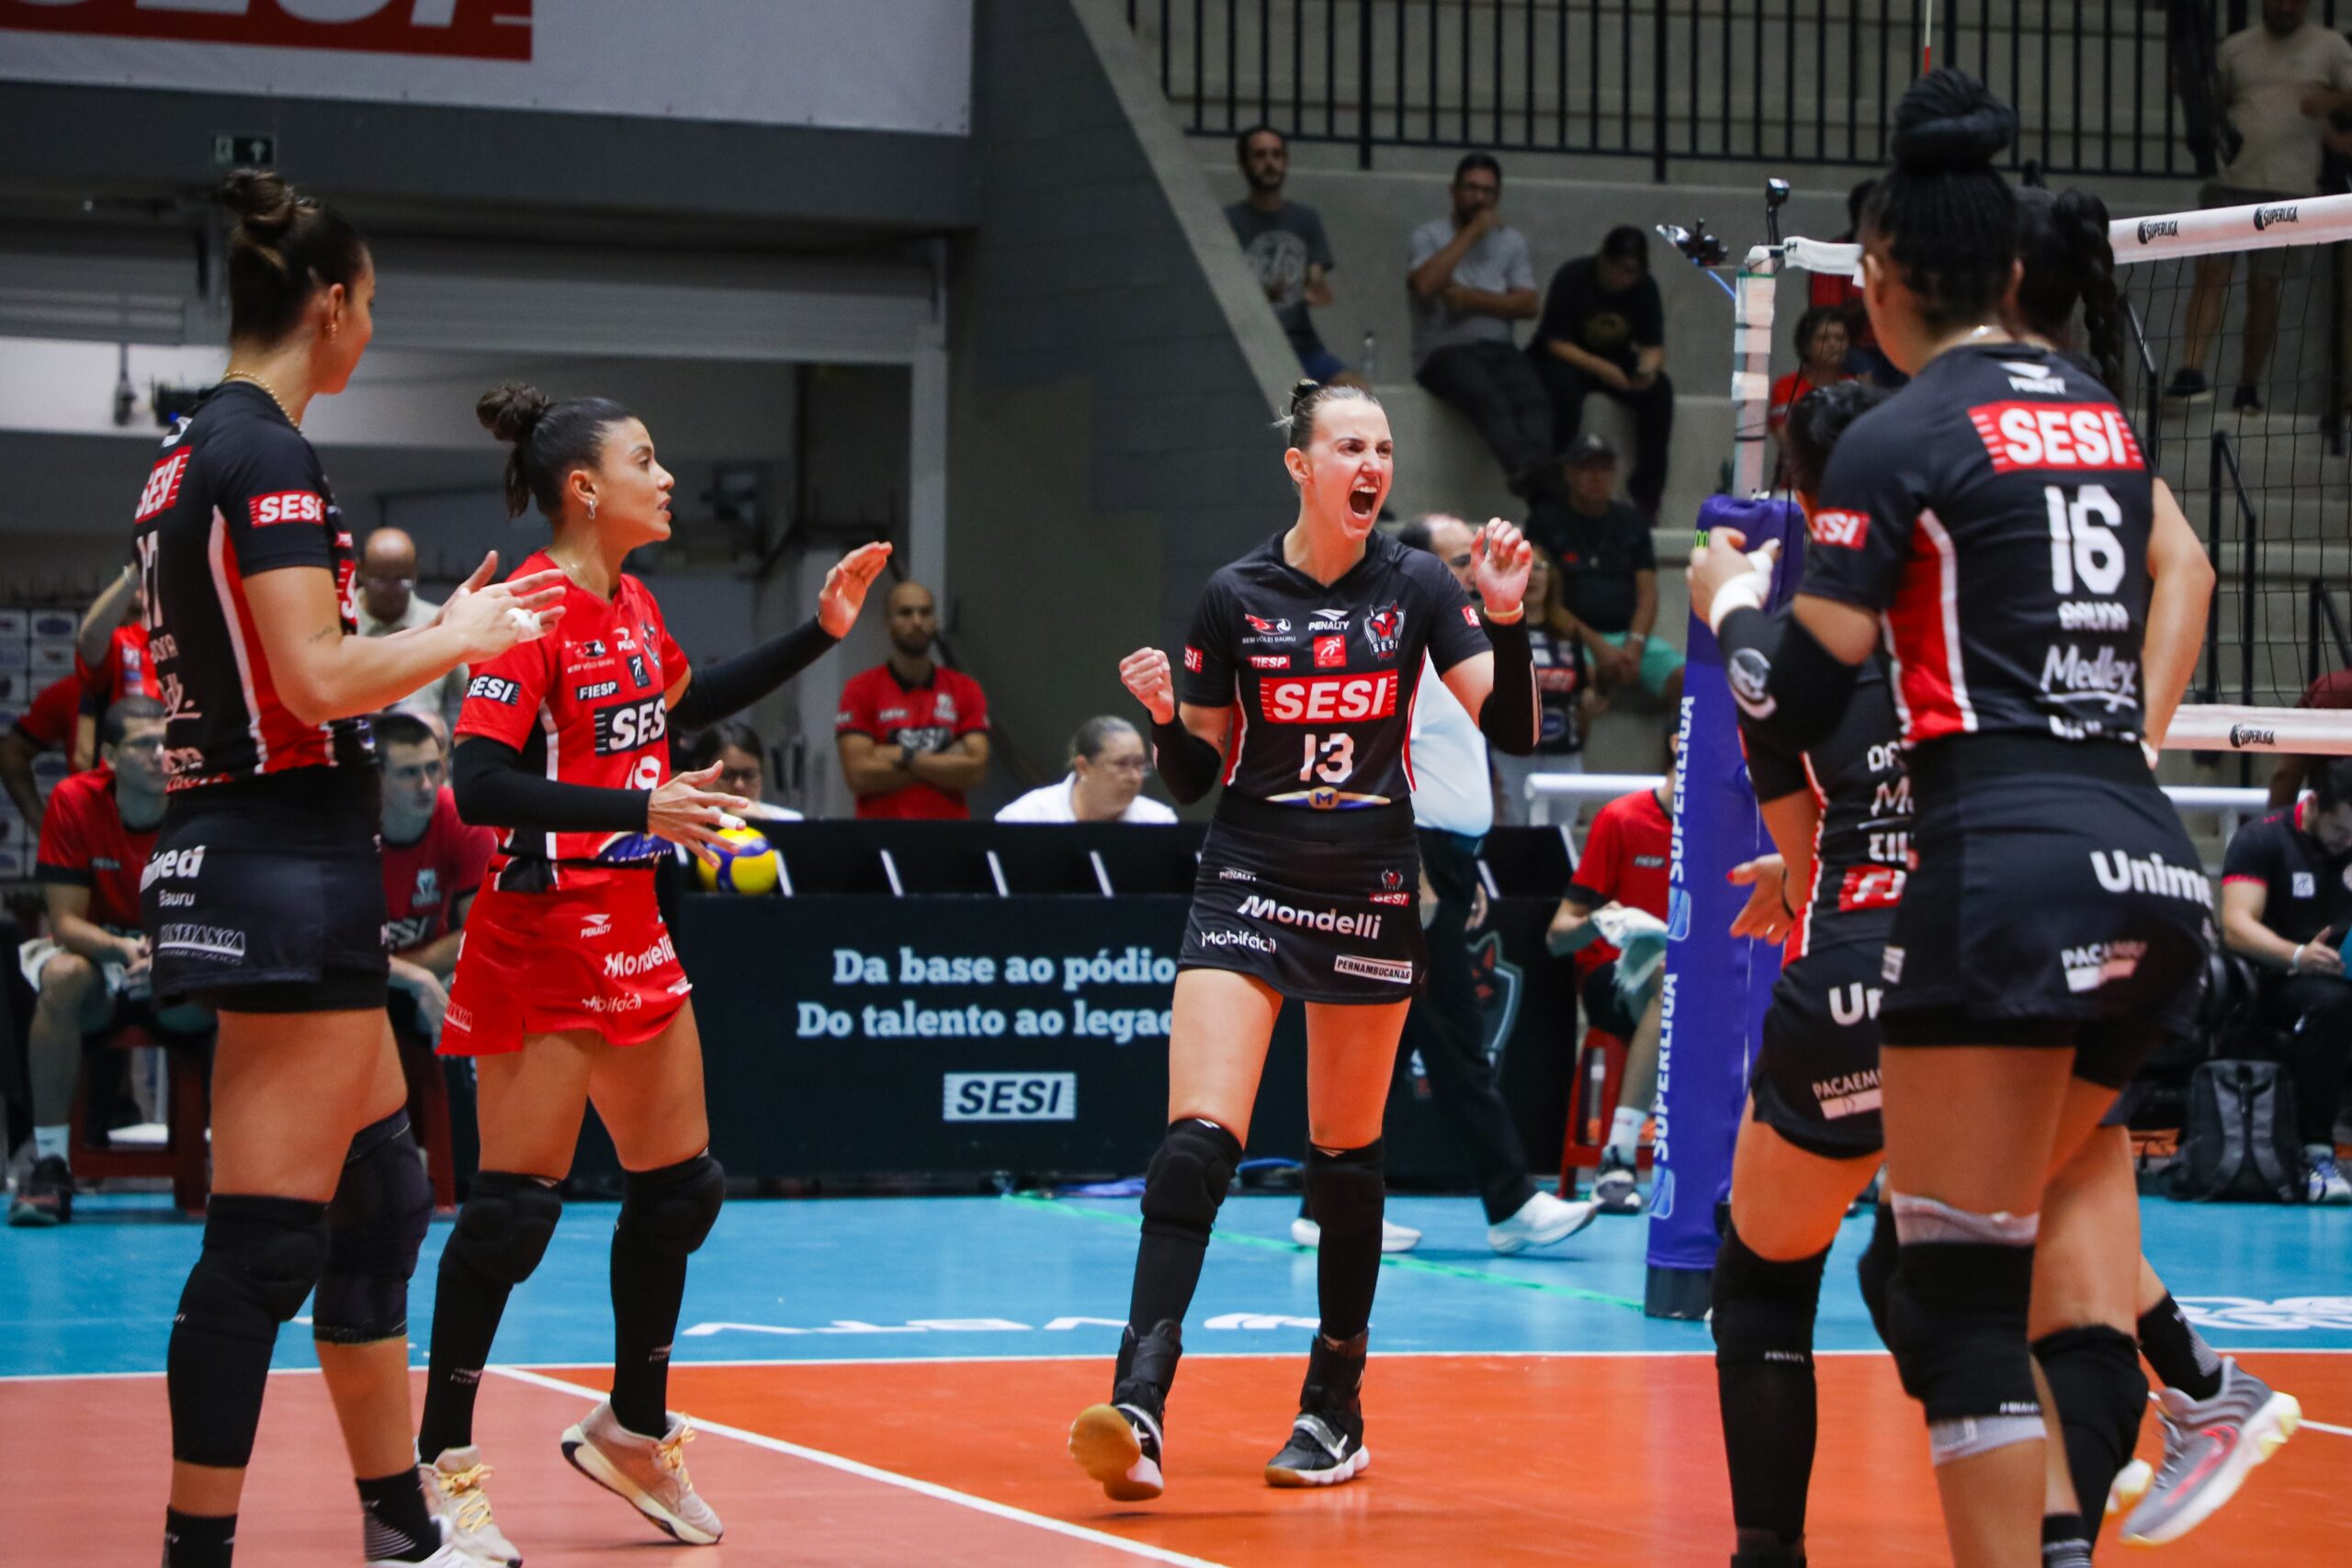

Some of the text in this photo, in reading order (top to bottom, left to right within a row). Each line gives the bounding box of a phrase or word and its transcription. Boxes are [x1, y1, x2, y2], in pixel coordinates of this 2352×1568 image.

[2146, 220, 2178, 241] SUPERLIGA
[2263, 207, 2299, 227] SUPERLIGA
[1999, 408, 2127, 465] SESI
[2045, 484, 2126, 594] 16
[1308, 621, 1350, 631] PENALTY
[579, 681, 616, 700] FIESP
[1272, 676, 1388, 720] SESI
[609, 697, 666, 750] SES
[1299, 732, 1355, 784] 13
[1237, 895, 1382, 940] Mondelli
[832, 946, 1176, 991] Da base ao pódio
[1337, 959, 1411, 980] PERNAMBUCANAS
[797, 1002, 853, 1037] Do
[862, 999, 1005, 1037] talento
[1015, 1009, 1064, 1036] ao
[956, 1079, 1062, 1116] SESI
[1813, 1067, 1883, 1100] PACAEM
